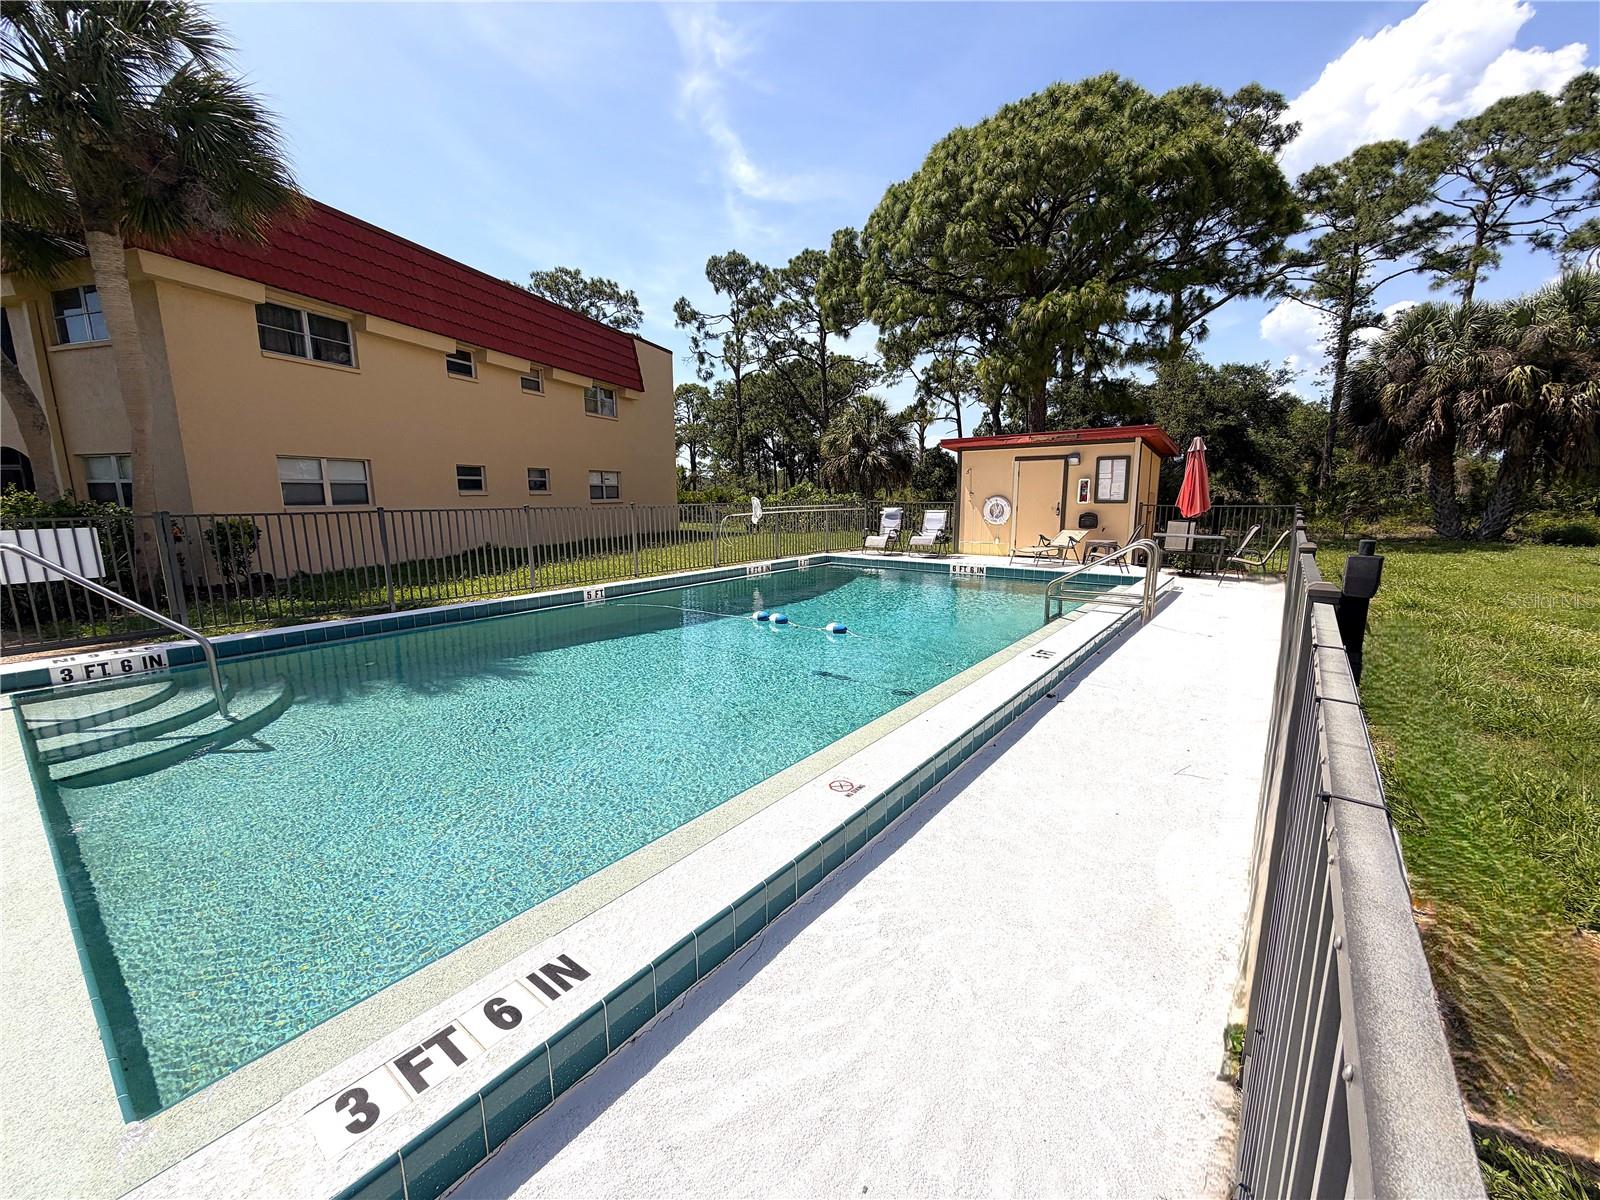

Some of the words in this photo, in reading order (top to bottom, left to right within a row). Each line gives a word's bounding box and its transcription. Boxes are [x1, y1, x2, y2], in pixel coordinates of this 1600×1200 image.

[587, 591, 592, 599] 5
[595, 589, 604, 598] FT
[60, 668, 74, 682] 3
[120, 659, 133, 673] 6
[335, 1087, 380, 1134] 3
[393, 1025, 468, 1094] FT
[483, 997, 523, 1030] 6
[526, 953, 592, 1001] IN
